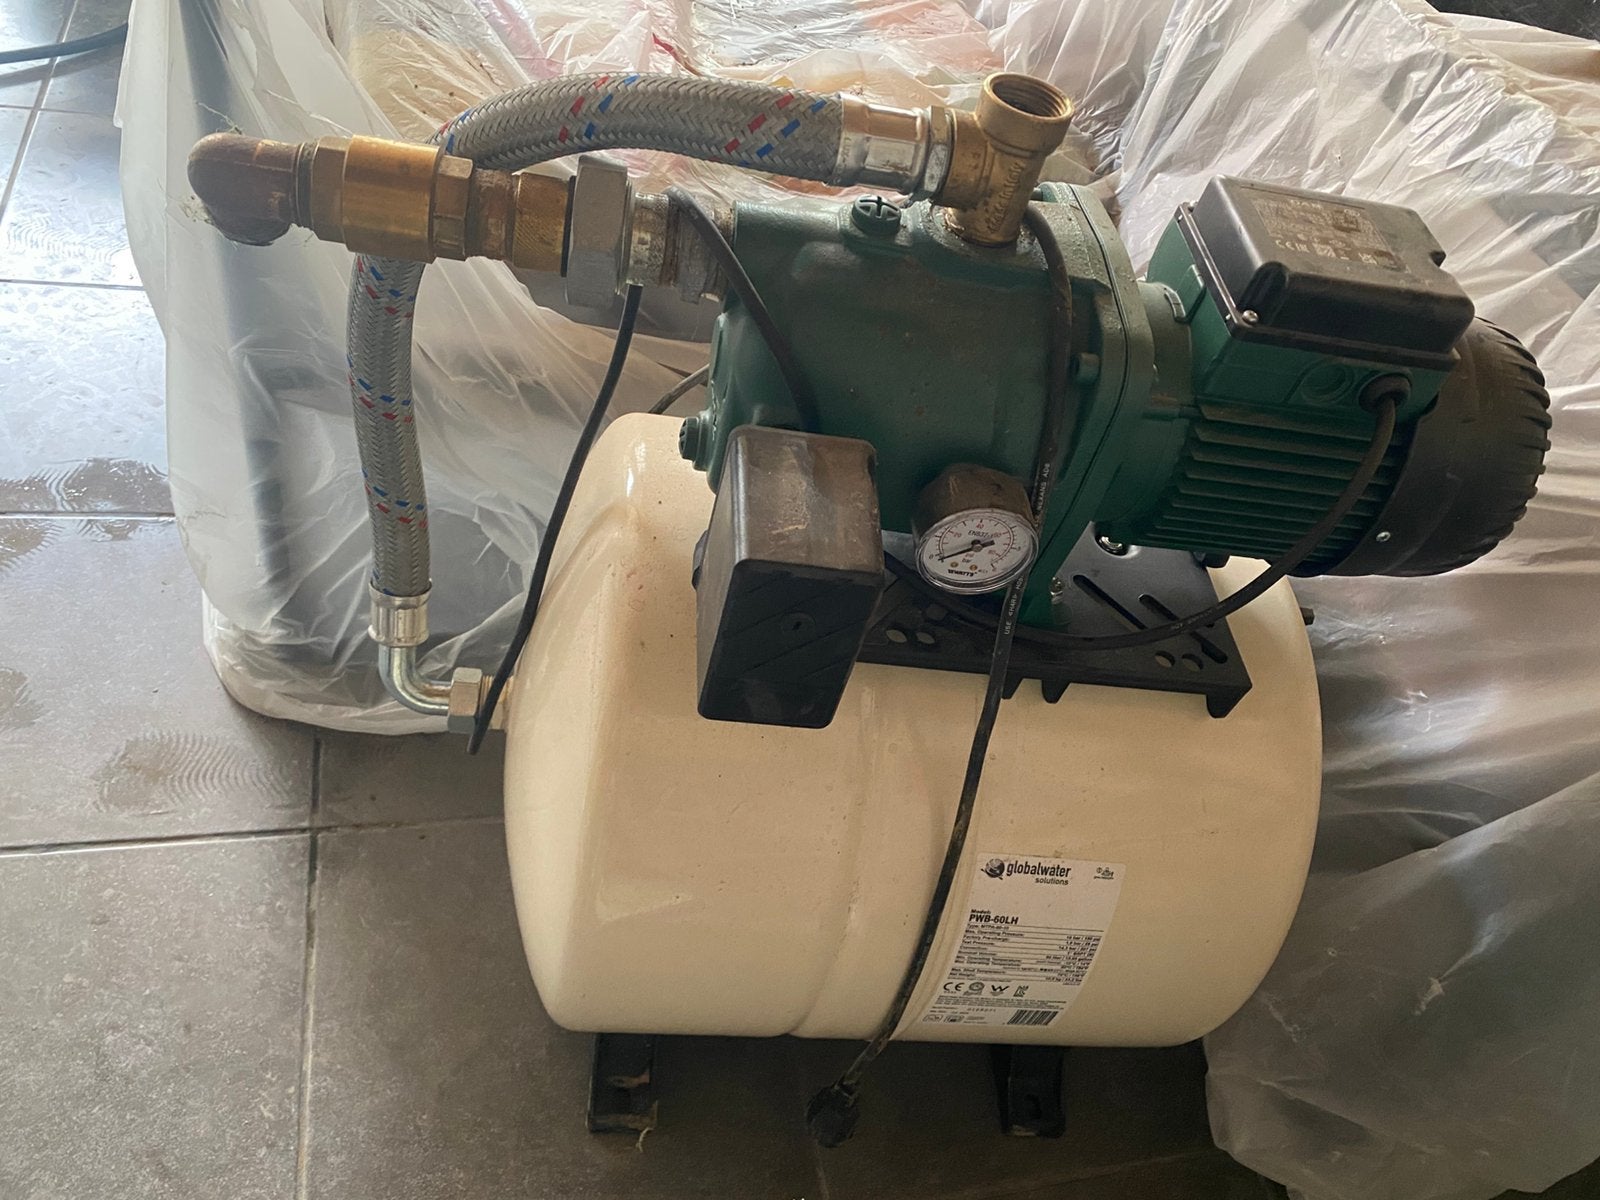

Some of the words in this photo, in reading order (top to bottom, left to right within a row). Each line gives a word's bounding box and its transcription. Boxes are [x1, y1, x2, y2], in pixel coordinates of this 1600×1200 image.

[1004, 621, 1012, 635] USE
[1006, 860, 1072, 877] globalwater
[1035, 877, 1069, 885] solutions
[969, 914, 1019, 924] PWB-60LH
